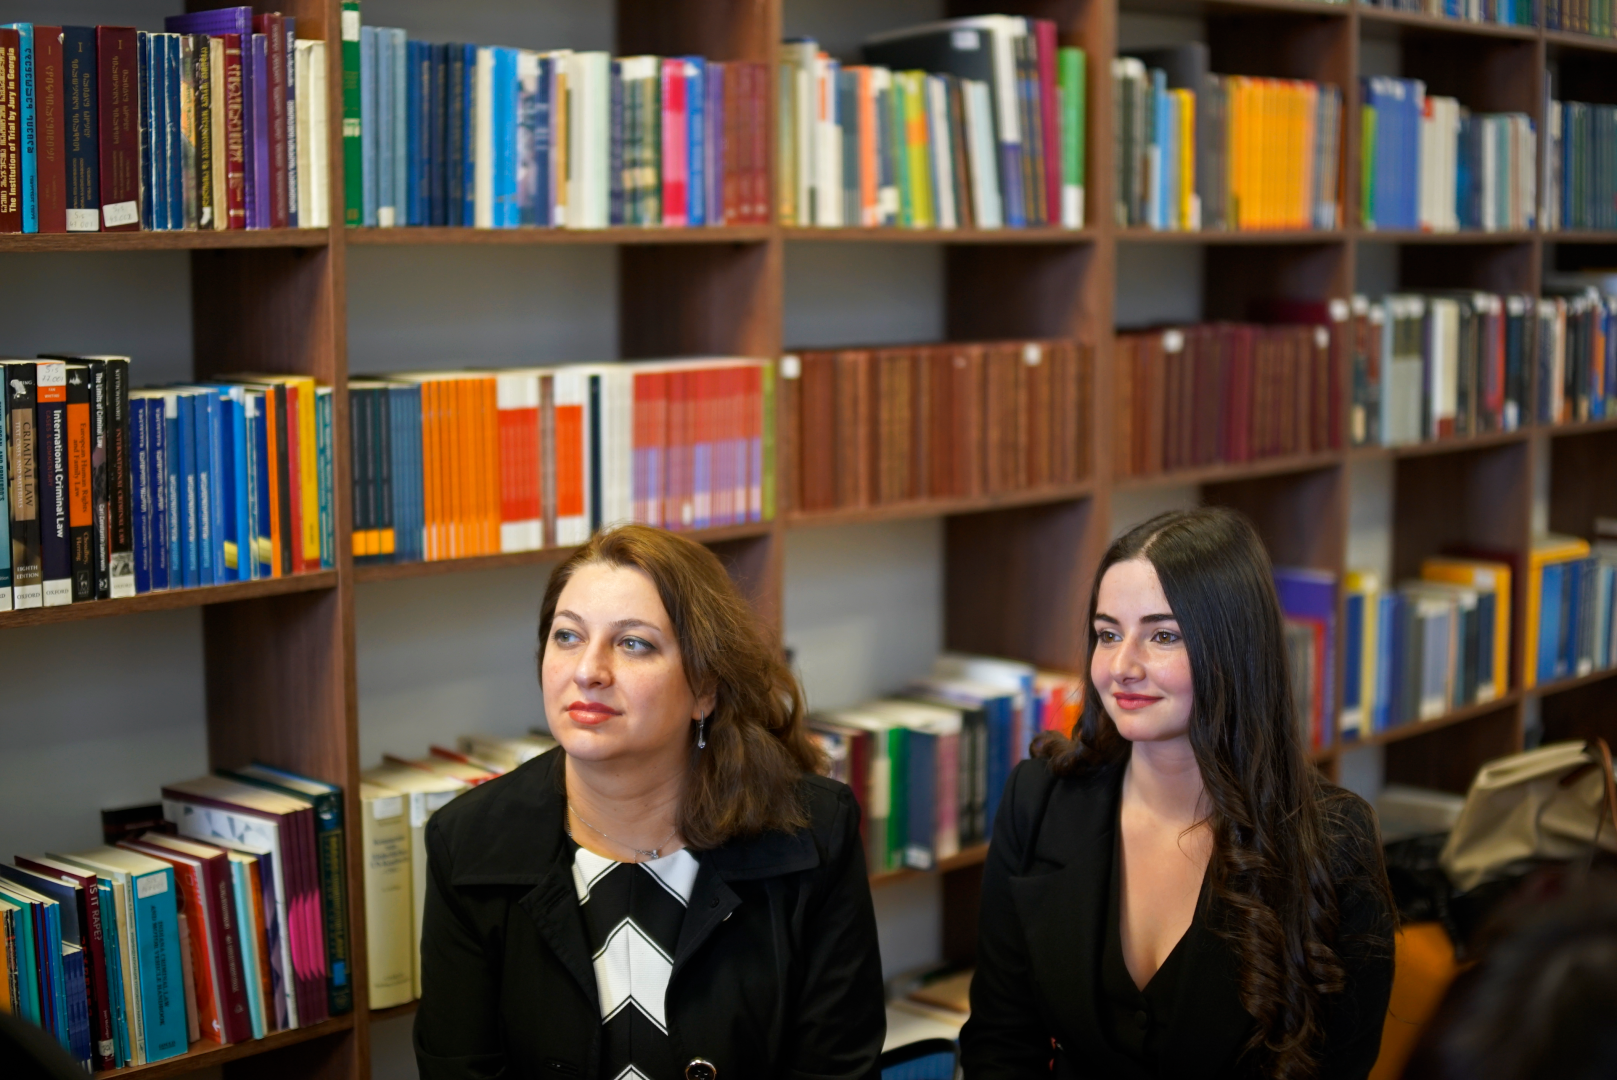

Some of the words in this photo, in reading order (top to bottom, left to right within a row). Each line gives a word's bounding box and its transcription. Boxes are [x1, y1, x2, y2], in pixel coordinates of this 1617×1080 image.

[7, 48, 16, 80] Georgia
[24, 48, 33, 109] ხელოვნება
[8, 91, 16, 109] Jury
[8, 111, 17, 121] by
[45, 65, 55, 162] კრიმინალისტიკა
[8, 143, 15, 152] of
[8, 154, 16, 195] Institution
[23, 422, 32, 481] CRIMINAL
[53, 410, 62, 473] International
[72, 455, 80, 479] Family
[24, 483, 33, 507] LAW
[55, 474, 63, 516] Criminal
[80, 490, 88, 513] Rights
[56, 518, 64, 538] Law
[89, 883, 98, 895] IS
[91, 896, 99, 906] IT
[92, 910, 102, 940] RAPE?
